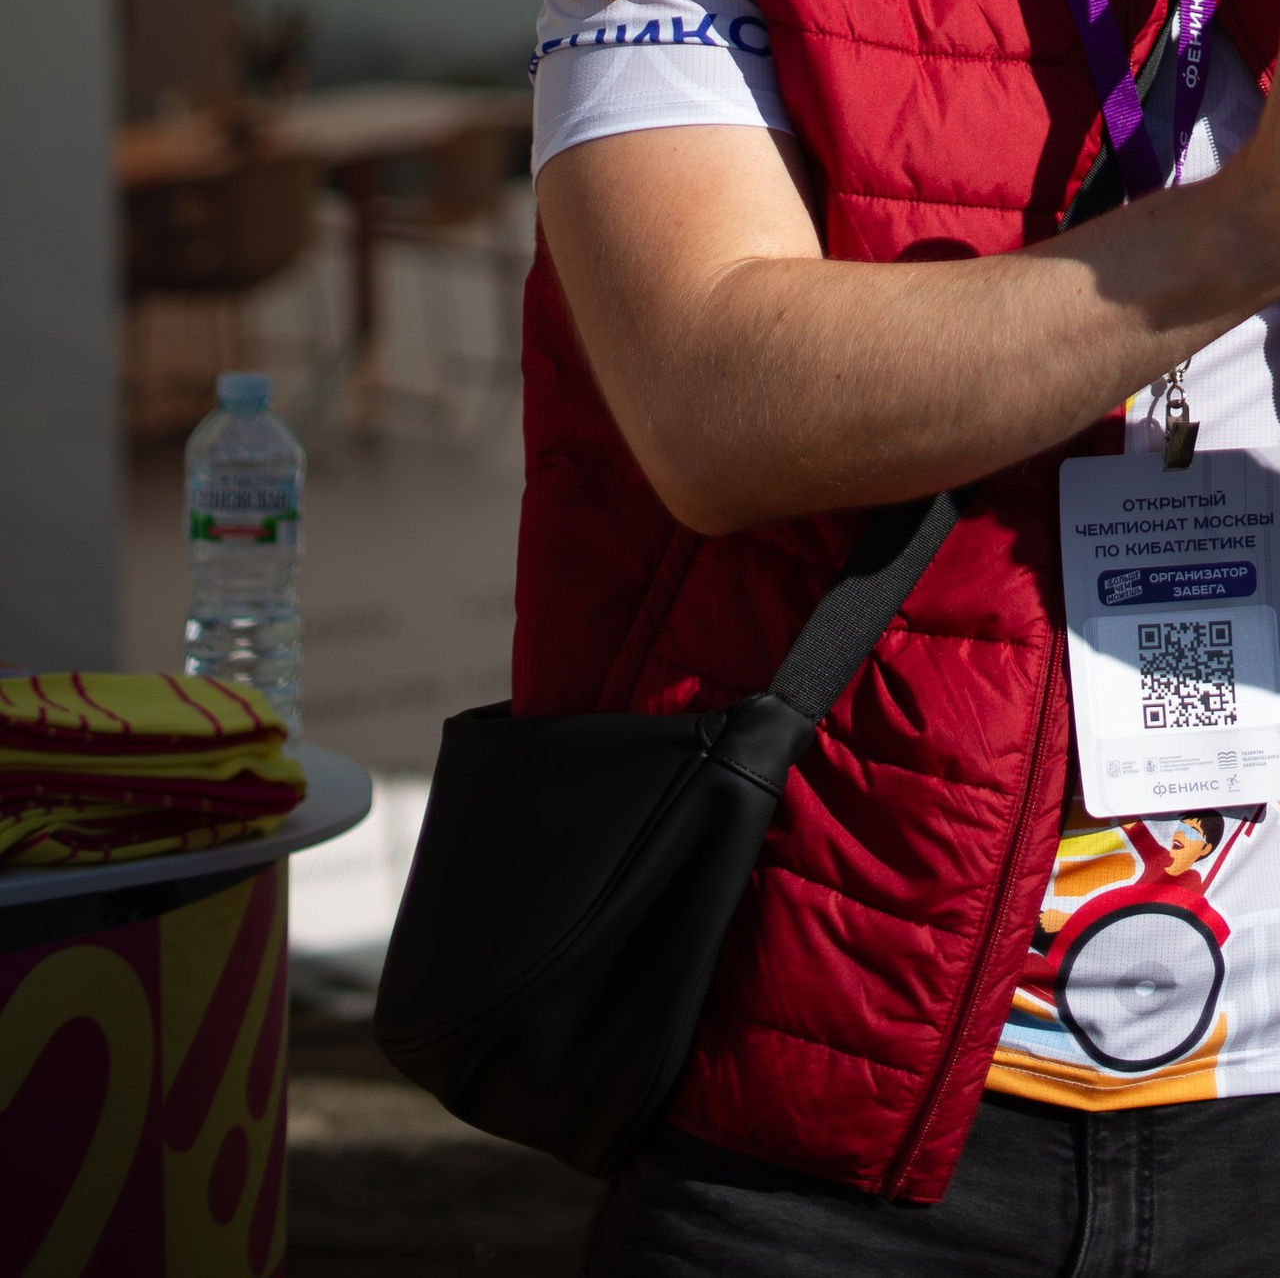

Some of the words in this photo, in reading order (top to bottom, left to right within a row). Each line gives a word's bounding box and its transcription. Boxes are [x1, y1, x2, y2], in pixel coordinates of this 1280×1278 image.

[1122, 490, 1226, 512] ОТКРЫТЫЙ
[1075, 517, 1188, 537] ЧЕМПИОНАТ
[1193, 512, 1274, 531] МОСКВЫ
[1095, 544, 1119, 559] ПО
[1125, 535, 1256, 556] КИБАТЛЕТИКЕ
[1149, 567, 1248, 583] ОРГАНИЗАТОР
[1106, 586, 1142, 604] МОЖЕШЬ
[1115, 581, 1132, 592] ЧЕМ
[1172, 583, 1226, 598] ЗАБЕГА
[1153, 779, 1220, 798] ФЕНИКС
